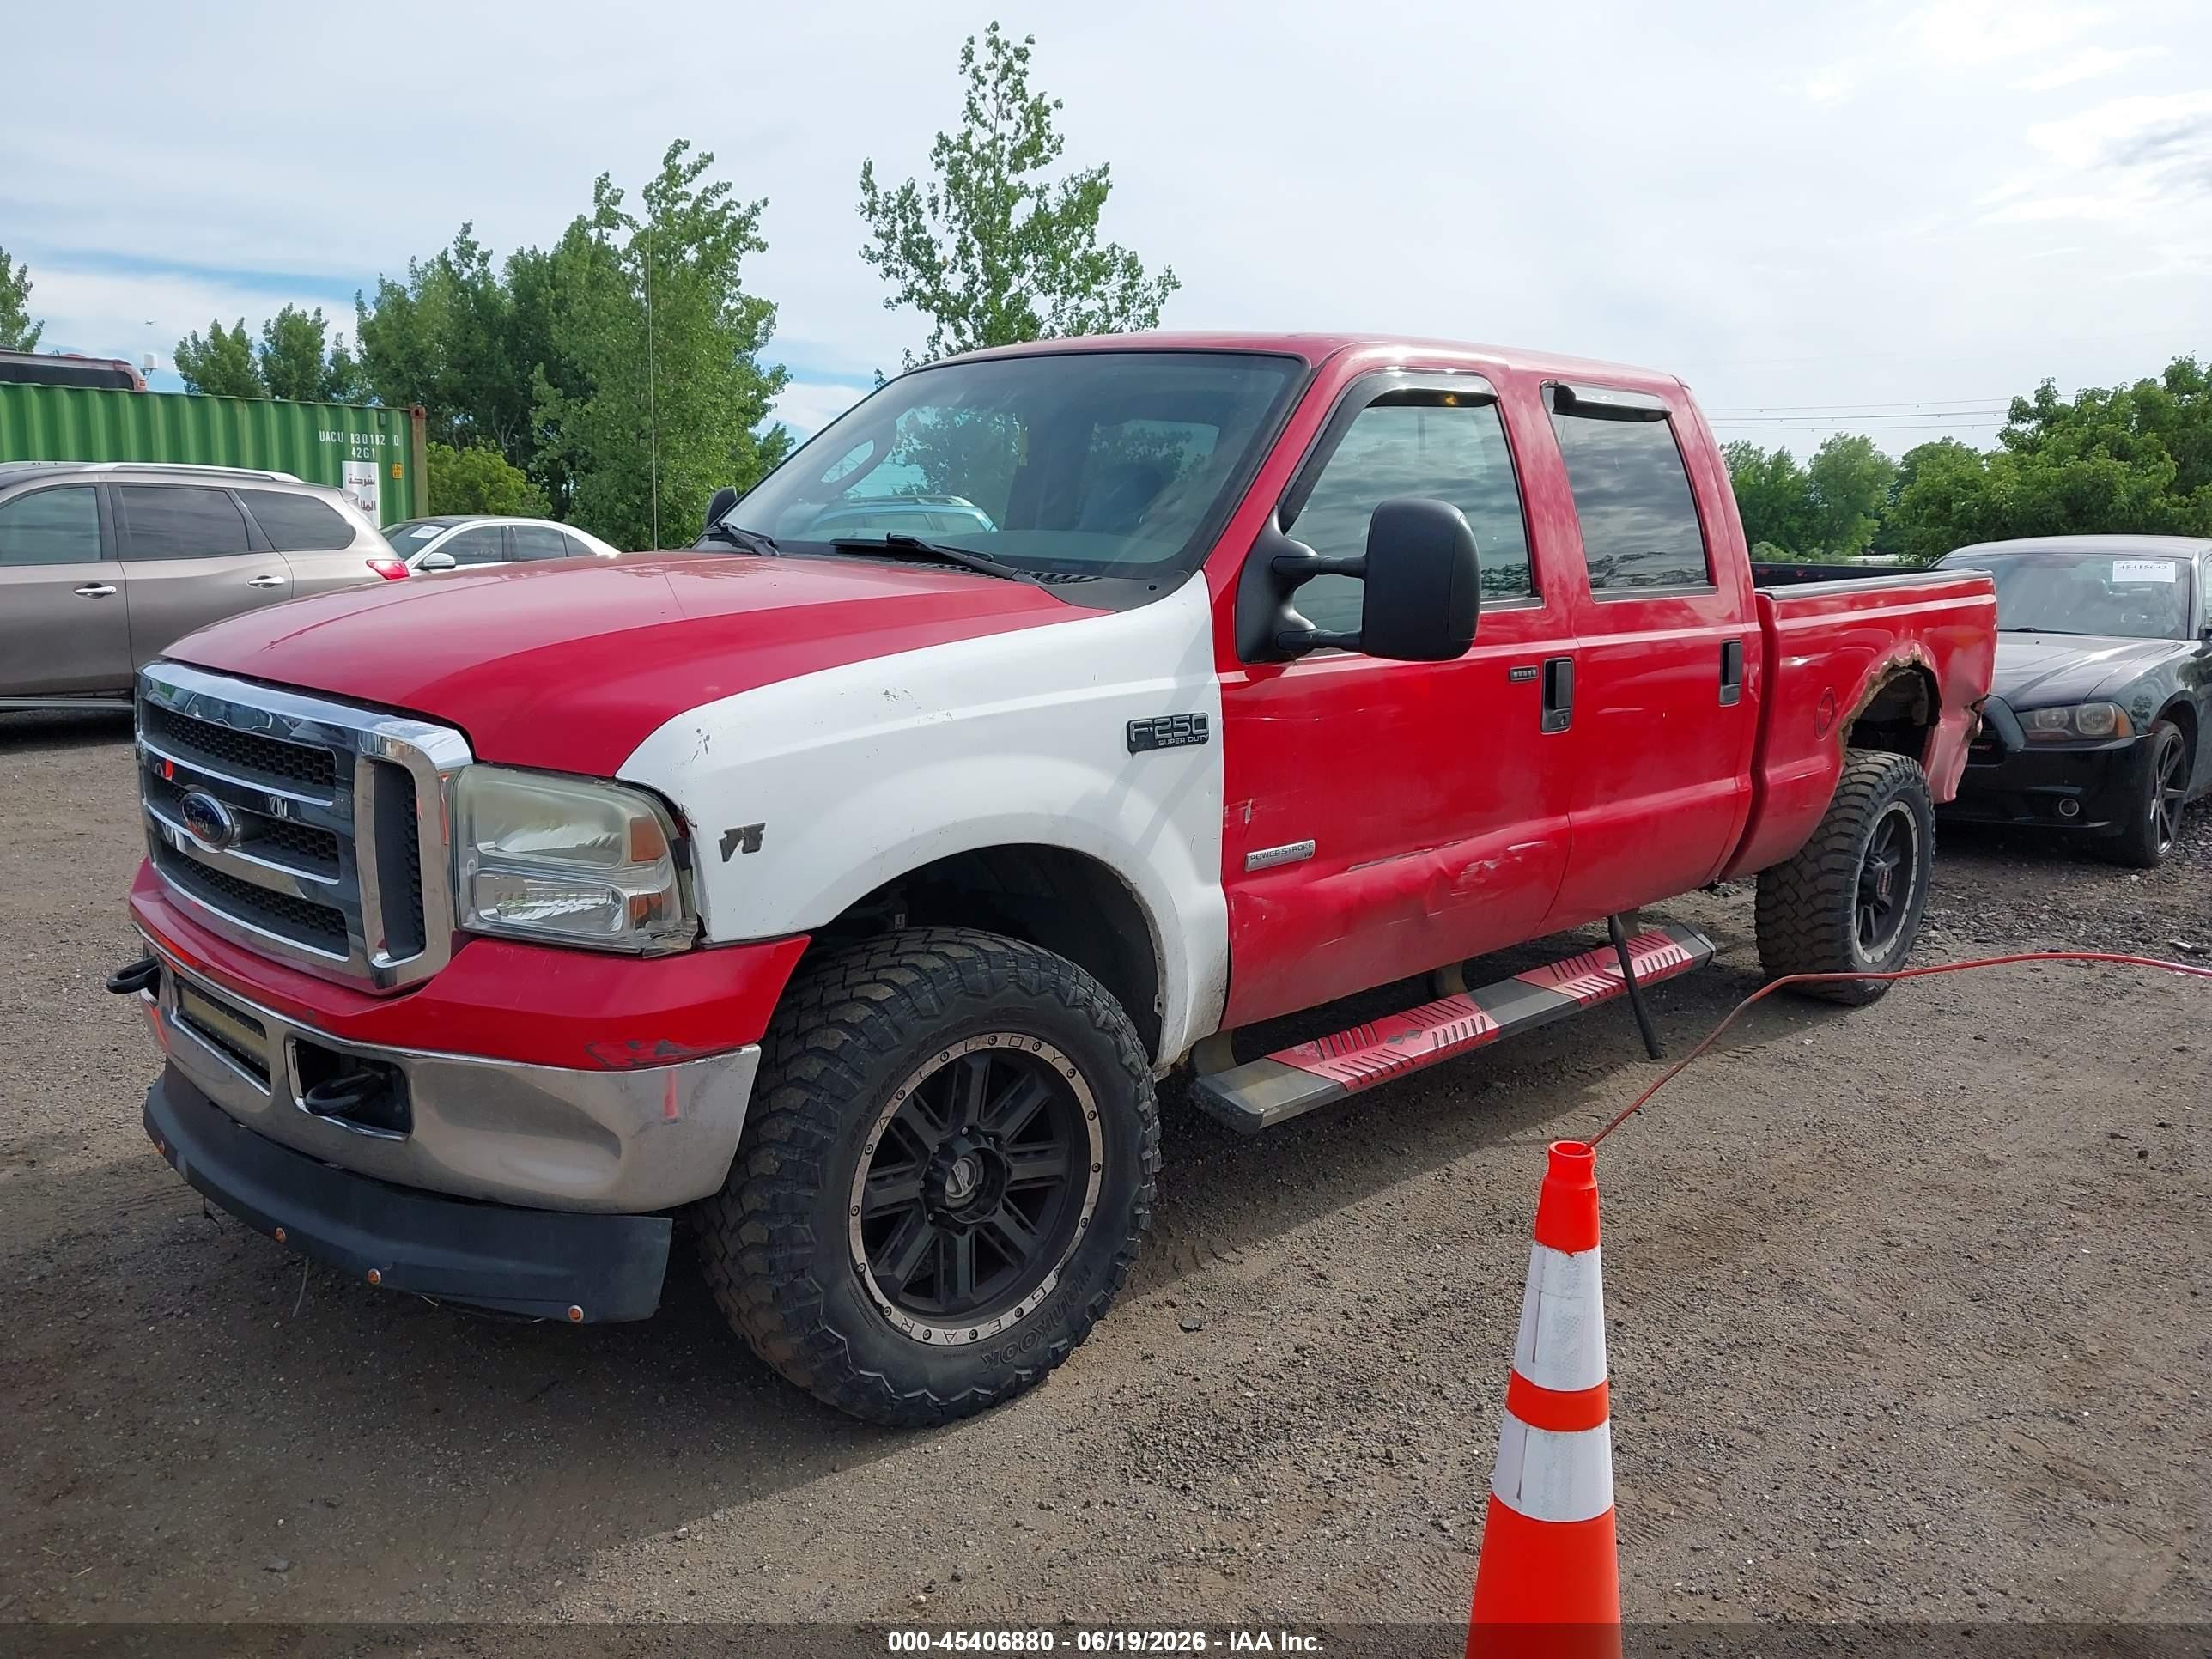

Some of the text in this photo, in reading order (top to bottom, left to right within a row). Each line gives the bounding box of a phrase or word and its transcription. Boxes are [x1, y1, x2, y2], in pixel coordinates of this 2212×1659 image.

[319, 431, 344, 443] UACU
[350, 433, 386, 446] 830182
[351, 447, 375, 459] 42G1
[348, 474, 375, 486] شركة
[360, 500, 377, 512] الملا
[1158, 734, 1209, 746] SUPER DUTY
